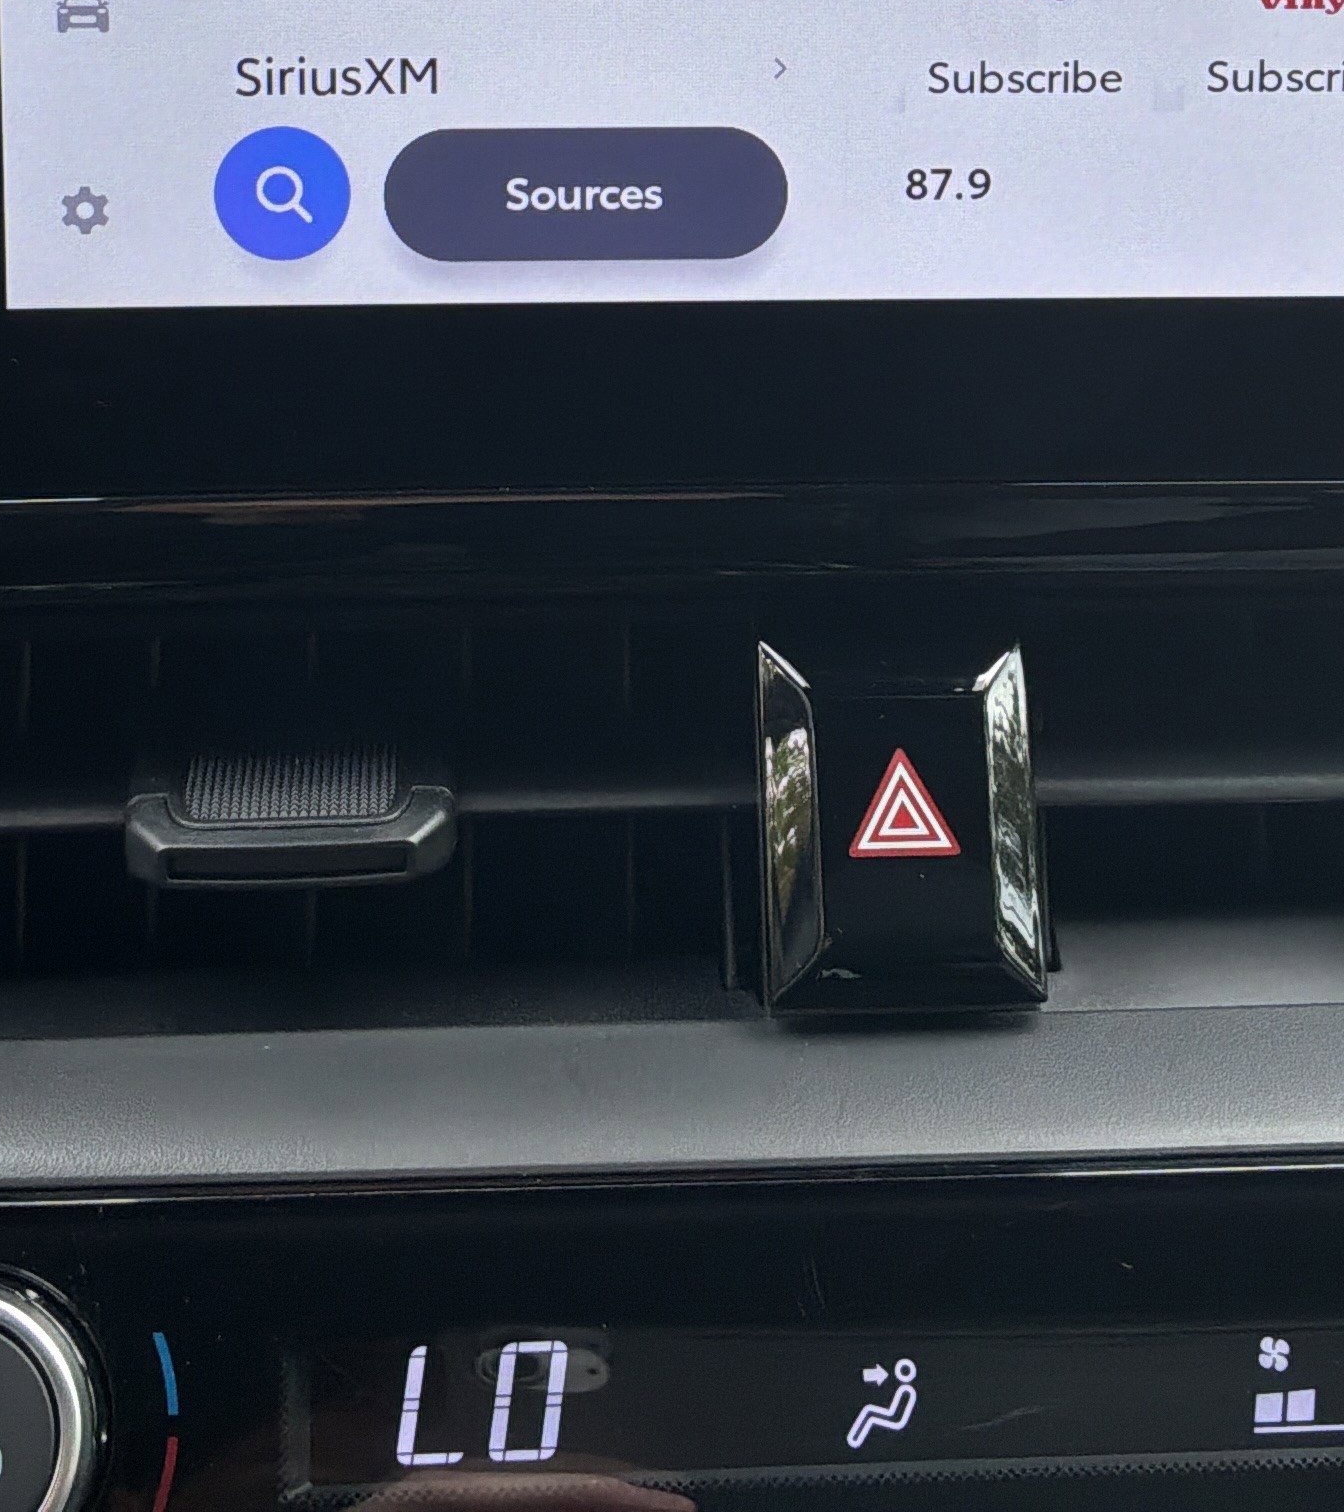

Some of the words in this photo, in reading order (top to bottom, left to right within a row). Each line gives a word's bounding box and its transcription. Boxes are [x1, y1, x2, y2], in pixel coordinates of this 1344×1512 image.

[235, 56, 439, 97] SiriusXM
[928, 59, 1123, 94] Subscribe
[506, 177, 664, 211] Sources
[905, 168, 992, 201] 87.9
